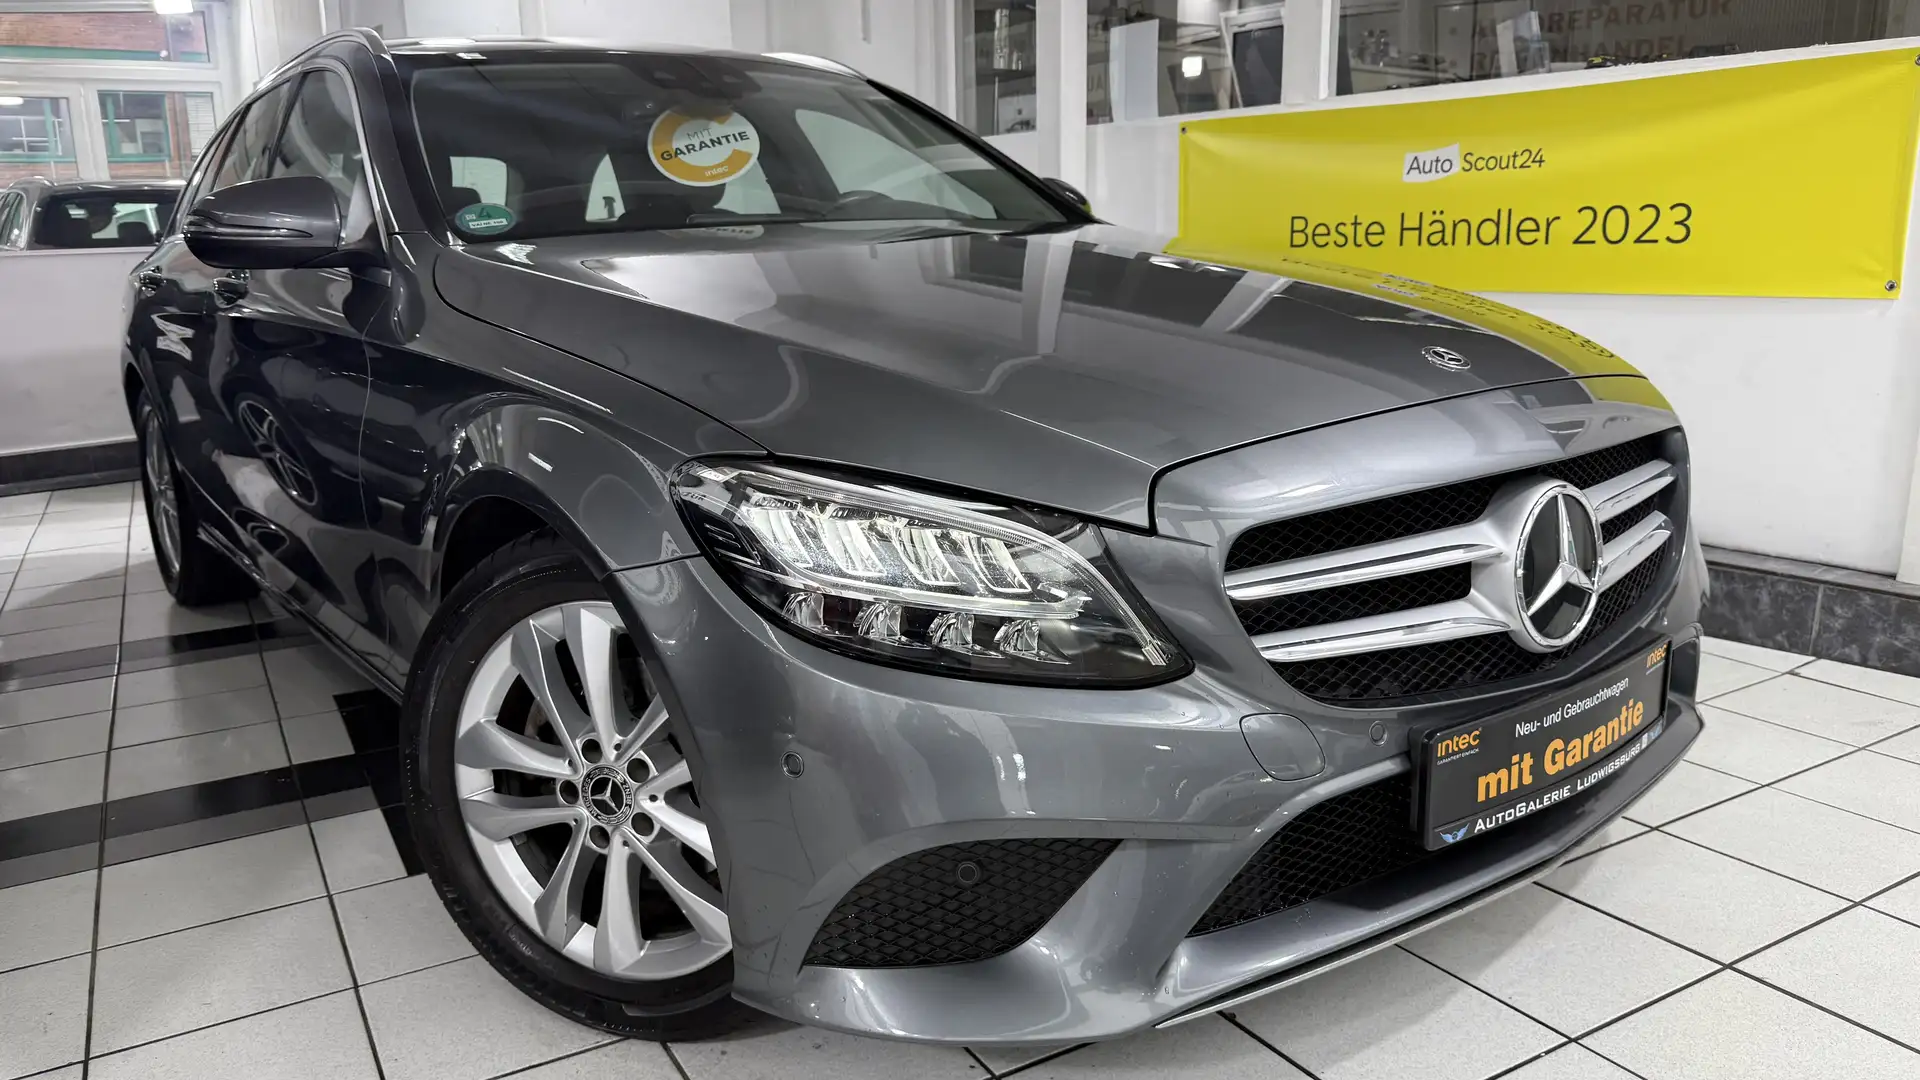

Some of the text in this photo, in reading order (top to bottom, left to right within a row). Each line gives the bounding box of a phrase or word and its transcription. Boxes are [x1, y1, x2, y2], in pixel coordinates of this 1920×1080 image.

[660, 131, 751, 161] GARANTIE
[686, 127, 713, 141] MIT
[704, 165, 729, 177] intec
[1406, 148, 1546, 176] Auto Scout24
[1289, 202, 1693, 249] Beste Händler 2023
[1646, 643, 1667, 669] intec
[1515, 677, 1629, 738] Neu- und Gebrauchtwagen
[1477, 698, 1644, 803] mit Garantie
[582, 777, 599, 817] MERCEDES
[622, 783, 633, 806] BENZ
